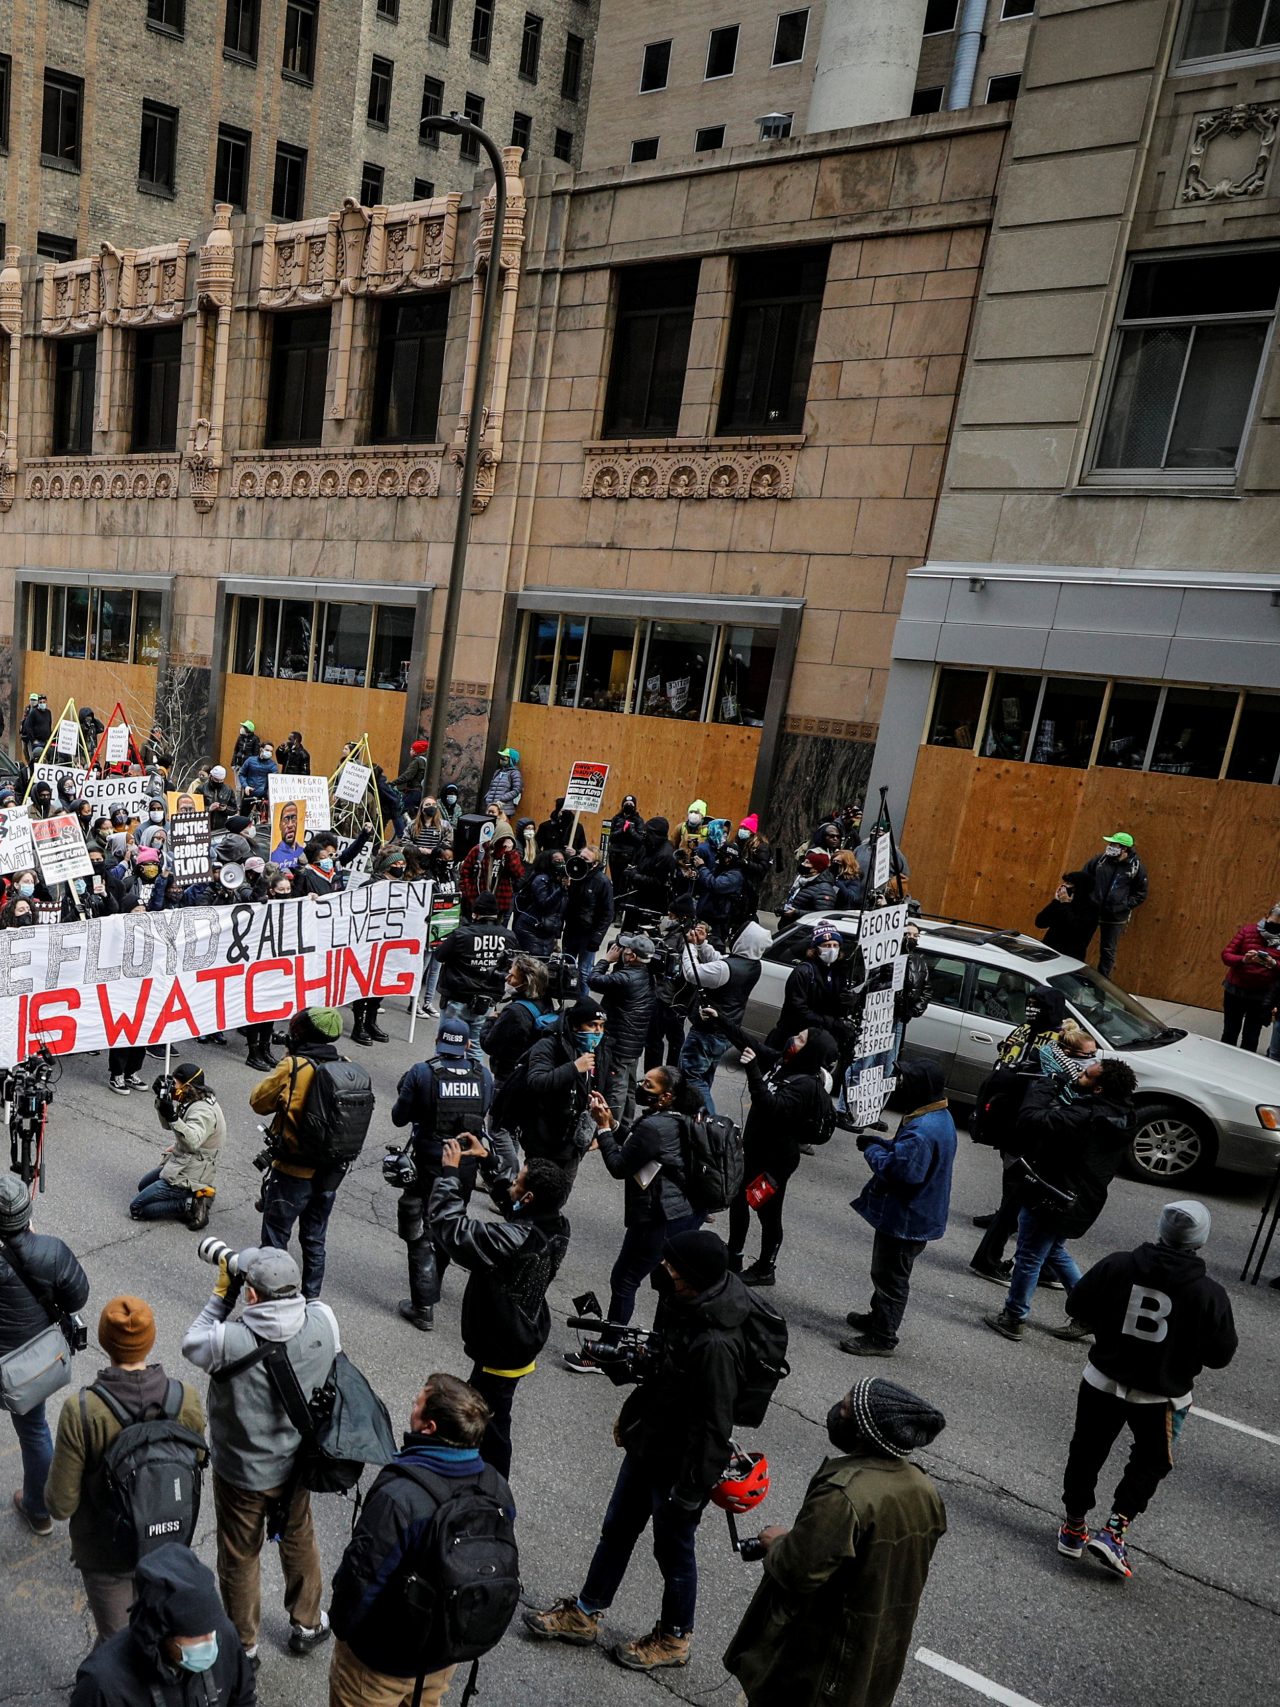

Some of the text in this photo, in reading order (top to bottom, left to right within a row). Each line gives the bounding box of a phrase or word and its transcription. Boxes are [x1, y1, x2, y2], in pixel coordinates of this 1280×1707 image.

[346, 770, 368, 780] VACCINATE
[350, 765, 366, 773] PLEASE
[84, 780, 148, 798] GEORGE
[298, 778, 322, 786] NEGRO
[346, 780, 360, 788] PLEASE
[91, 800, 140, 817] FLYD
[172, 820, 208, 836] JUSTICE
[39, 838, 74, 849] JUSTICE FOR
[186, 835, 196, 843] FOR
[42, 850, 86, 864] GEORGE FLOYD
[174, 843, 209, 860] GEORGE
[174, 856, 210, 876] FLOYD
[315, 881, 426, 921] STOLEN
[332, 910, 406, 948] LIVES
[862, 910, 909, 938] GEORGE
[46, 906, 222, 992] FLOYD
[227, 905, 253, 964] &
[257, 901, 316, 961] ALL
[474, 935, 506, 952] DEUS
[863, 938, 898, 965] FLOYD
[18, 988, 81, 1064] IS
[97, 938, 420, 1047] WATCHING
[442, 1032, 464, 1043] PRESS
[860, 1067, 882, 1082] FOUR
[441, 1082, 480, 1097] MEDIA
[848, 1079, 894, 1101] DIRECTIONS
[858, 1096, 882, 1113] BLACK
[858, 1110, 879, 1126] WEST
[1122, 1285, 1172, 1343] B
[149, 1520, 180, 1536] PRESS
